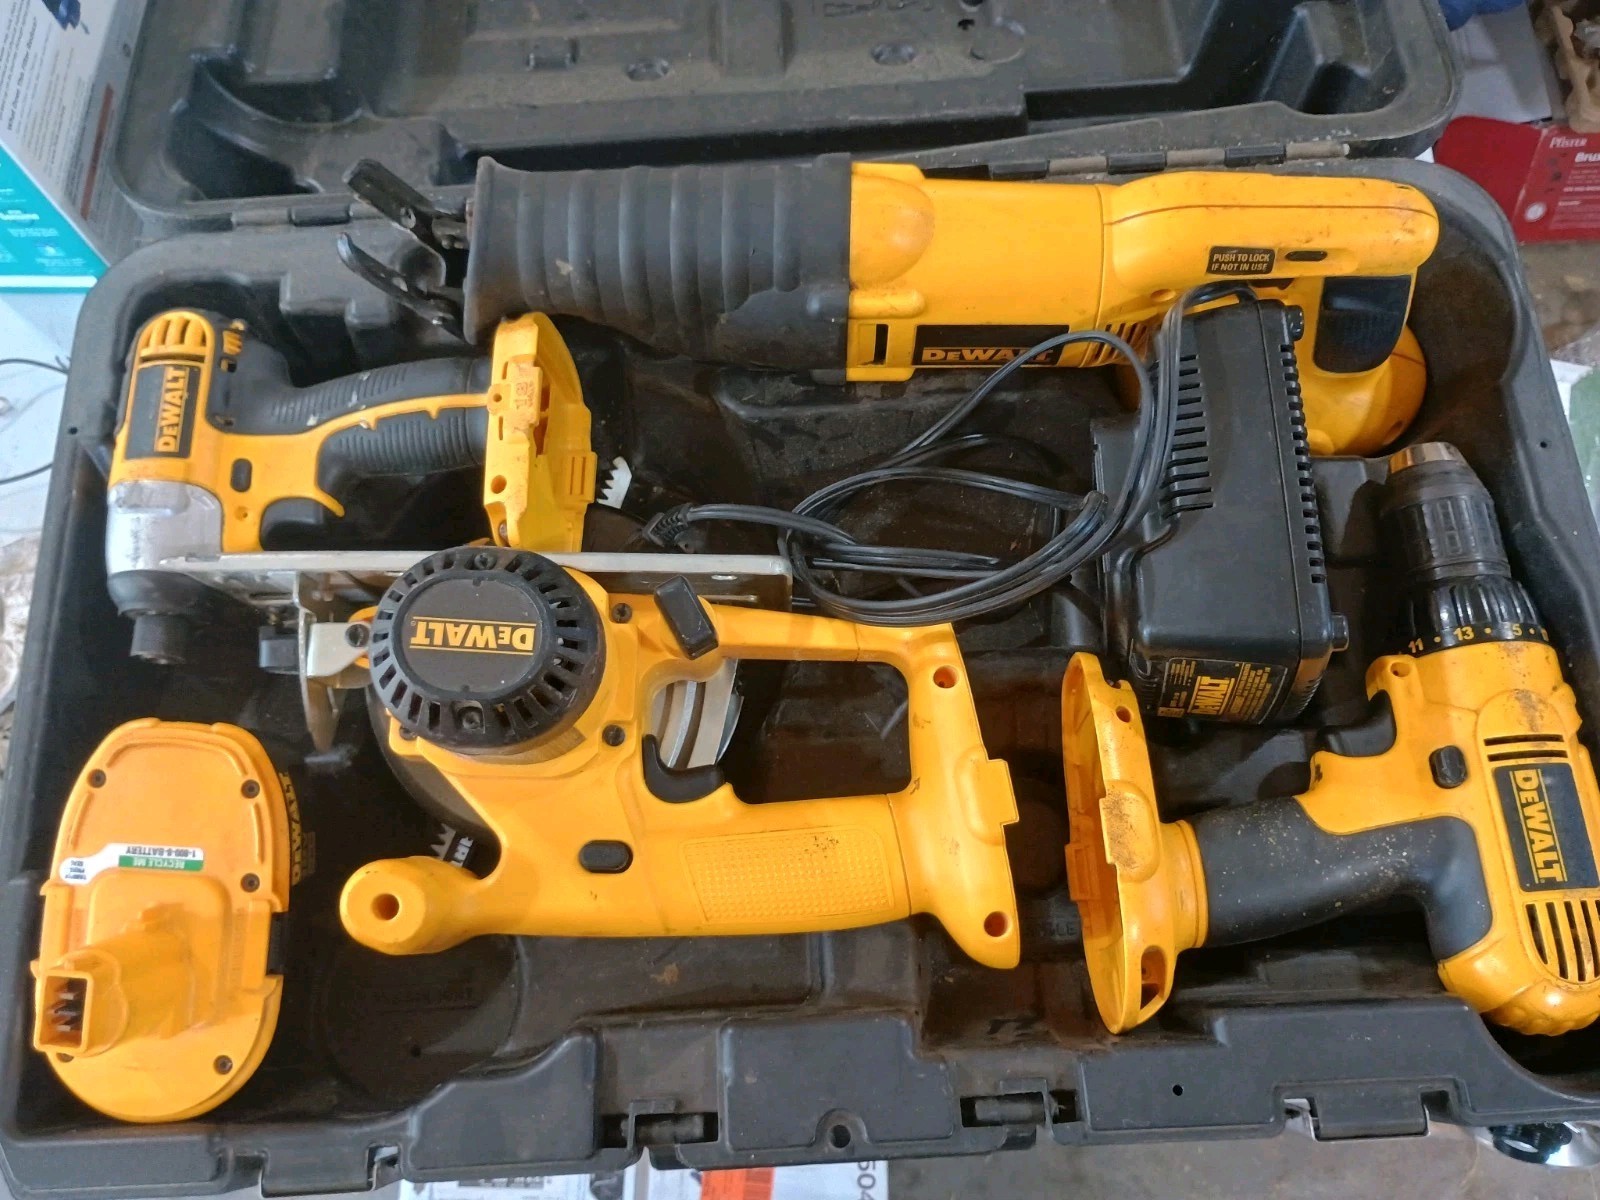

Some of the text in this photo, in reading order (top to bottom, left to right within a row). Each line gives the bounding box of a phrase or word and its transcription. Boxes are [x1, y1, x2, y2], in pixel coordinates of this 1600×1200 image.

[1211, 263, 1267, 271] IF NOT IN USE
[1213, 253, 1270, 262] PUSH TO LOCK
[410, 621, 535, 651] DEWALT
[1408, 637, 1424, 653] 11
[1453, 626, 1475, 641] 13
[1513, 769, 1564, 882] DEWALT
[132, 856, 185, 869] RECYCLE ME
